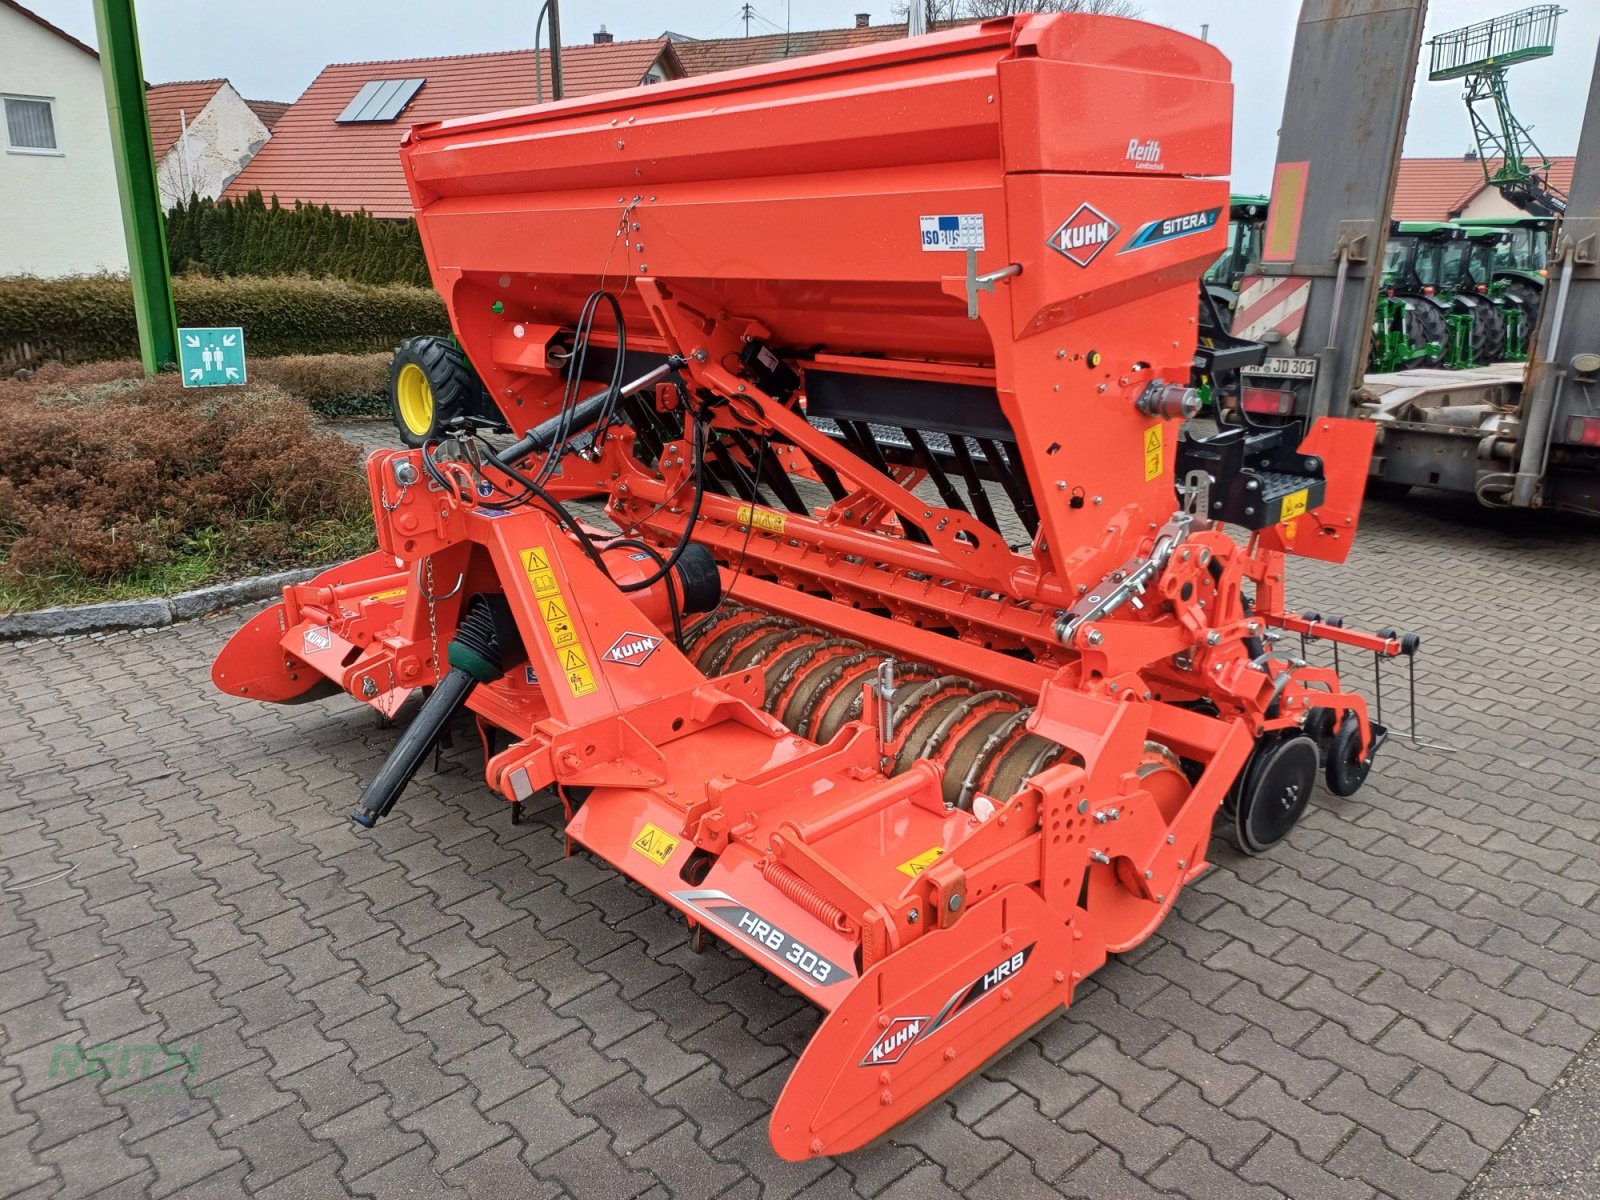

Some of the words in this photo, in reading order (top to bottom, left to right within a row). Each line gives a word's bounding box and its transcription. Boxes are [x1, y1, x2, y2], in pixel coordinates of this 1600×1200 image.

[1125, 139, 1161, 161] Reith
[1162, 213, 1207, 235] SITERA
[1060, 222, 1109, 250] KUHN
[1273, 359, 1289, 373] JD
[1291, 360, 1314, 374] 301
[306, 631, 329, 649] KUHN
[611, 638, 654, 660] KUHN
[738, 912, 785, 951] HRB
[785, 942, 831, 982] 303
[984, 952, 1024, 990] HRB
[872, 1020, 920, 1063] KUHN
